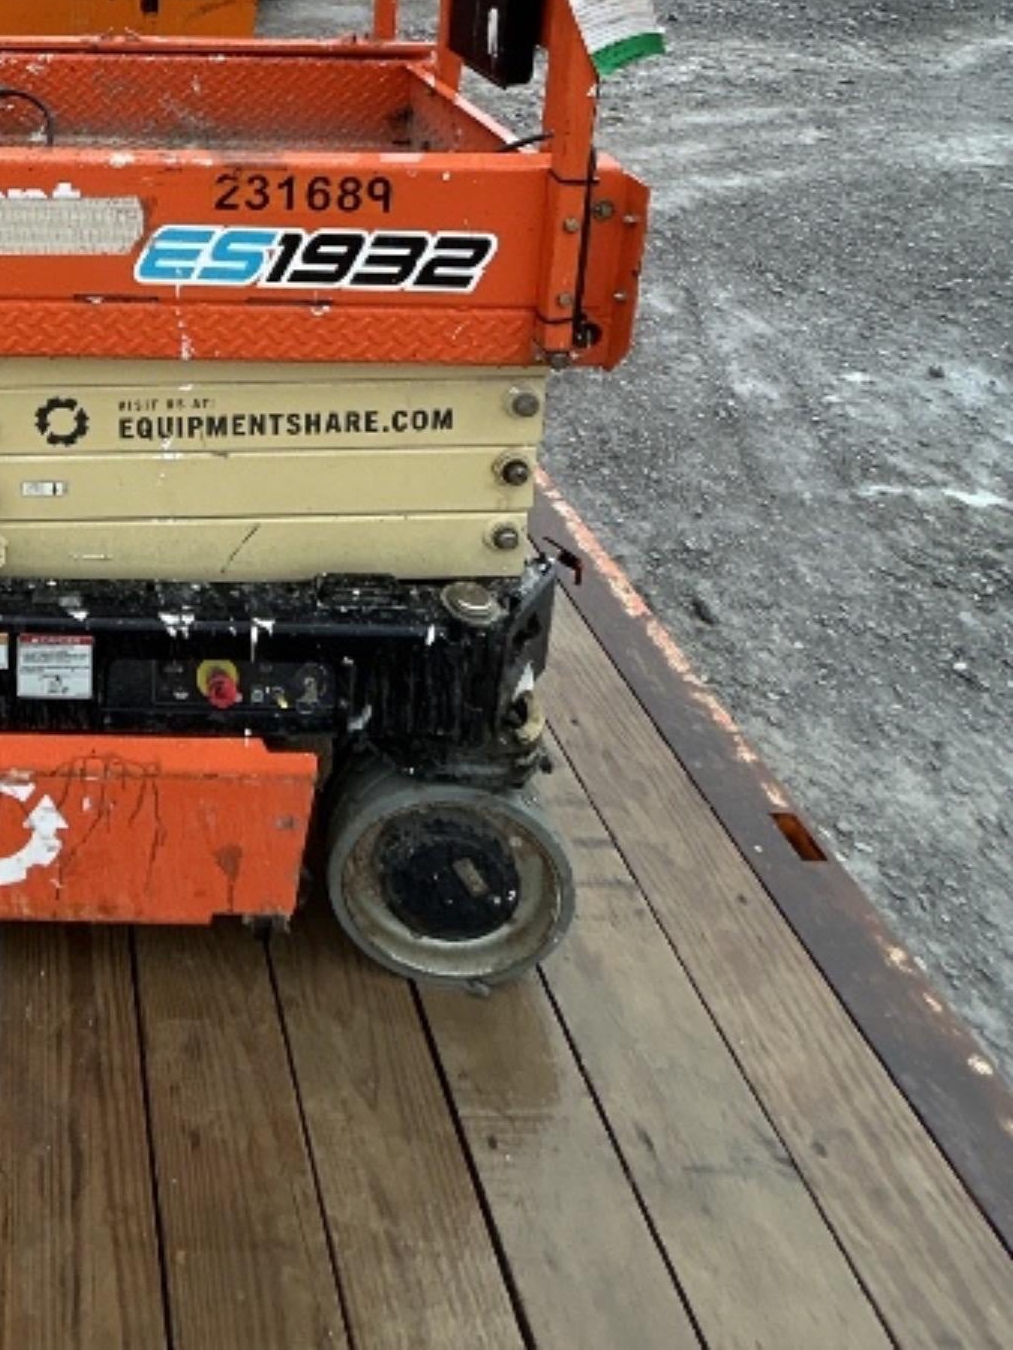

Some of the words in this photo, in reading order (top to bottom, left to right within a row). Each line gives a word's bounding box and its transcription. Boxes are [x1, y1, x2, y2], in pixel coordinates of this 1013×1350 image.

[214, 173, 394, 213] 231689
[136, 227, 496, 291] ES1932
[118, 407, 454, 440] EQUIPMENTSHARE.COM
